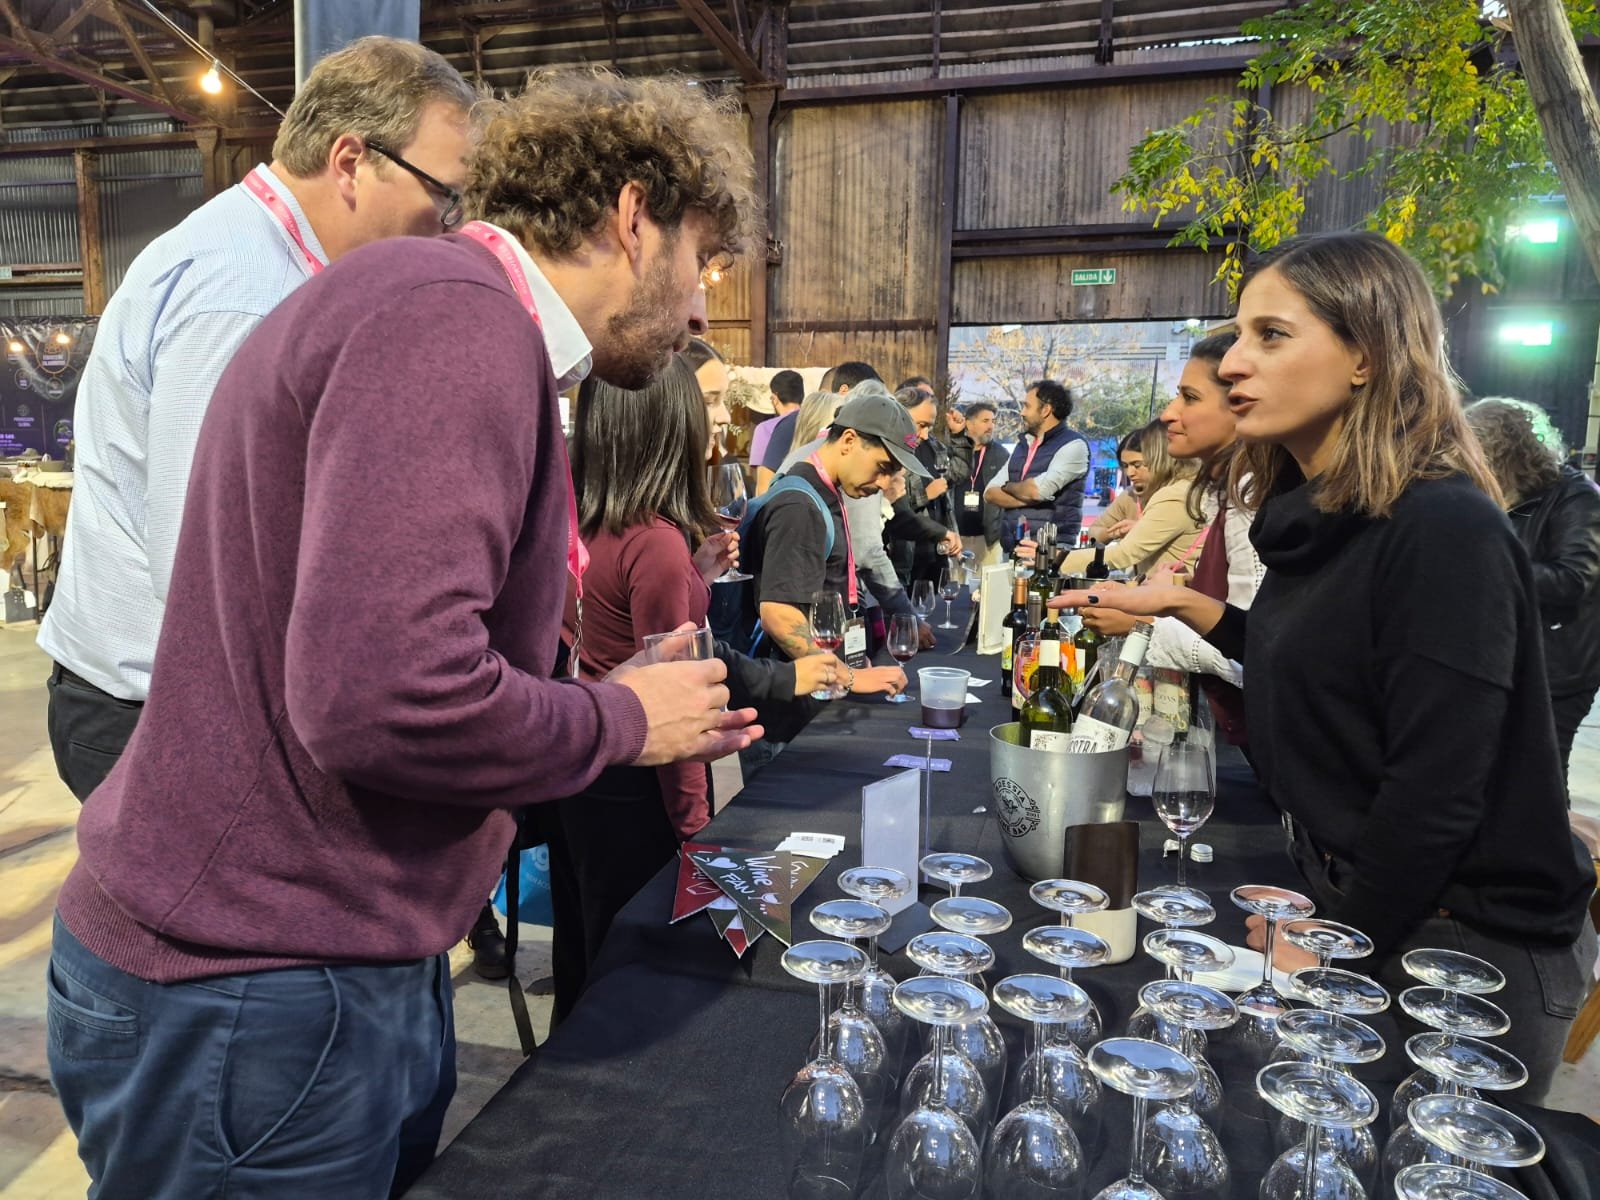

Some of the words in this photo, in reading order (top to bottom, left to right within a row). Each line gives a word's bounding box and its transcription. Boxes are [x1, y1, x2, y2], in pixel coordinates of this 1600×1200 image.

[1074, 273, 1098, 281] SALIDA
[1012, 823, 1028, 835] BAR
[744, 855, 782, 886] Wine
[720, 873, 755, 894] FAN
